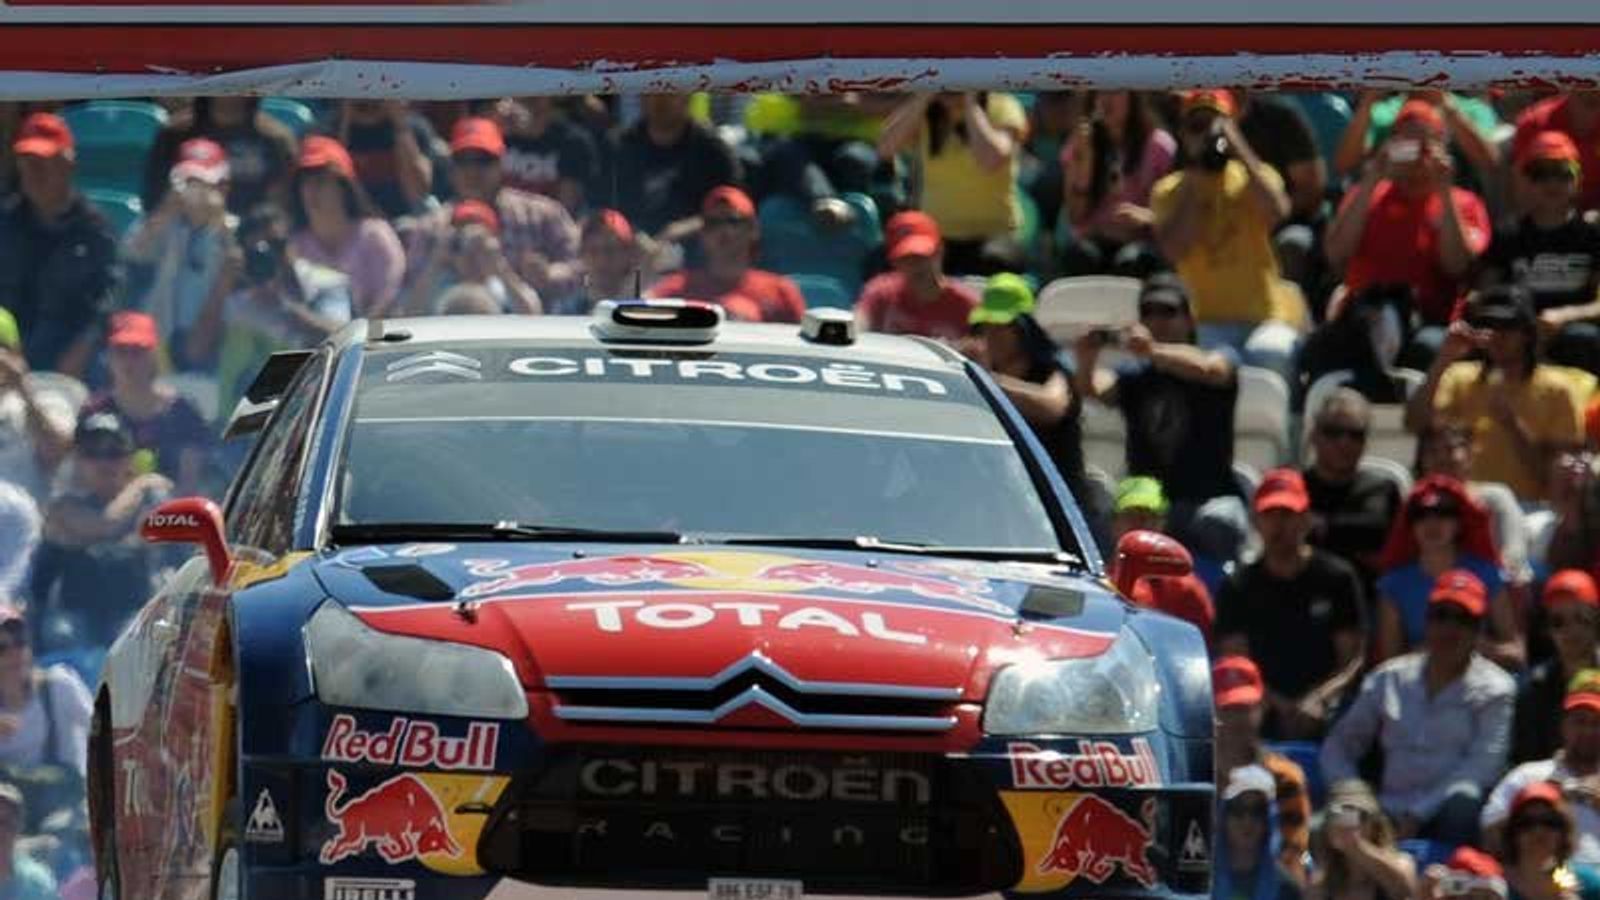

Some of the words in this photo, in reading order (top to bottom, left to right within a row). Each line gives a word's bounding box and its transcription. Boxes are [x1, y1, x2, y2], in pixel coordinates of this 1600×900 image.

[147, 513, 200, 528] TOTAL
[566, 600, 927, 644] TOTAL
[321, 714, 407, 765] Red
[399, 720, 499, 770] Bull
[1008, 740, 1100, 787] Red
